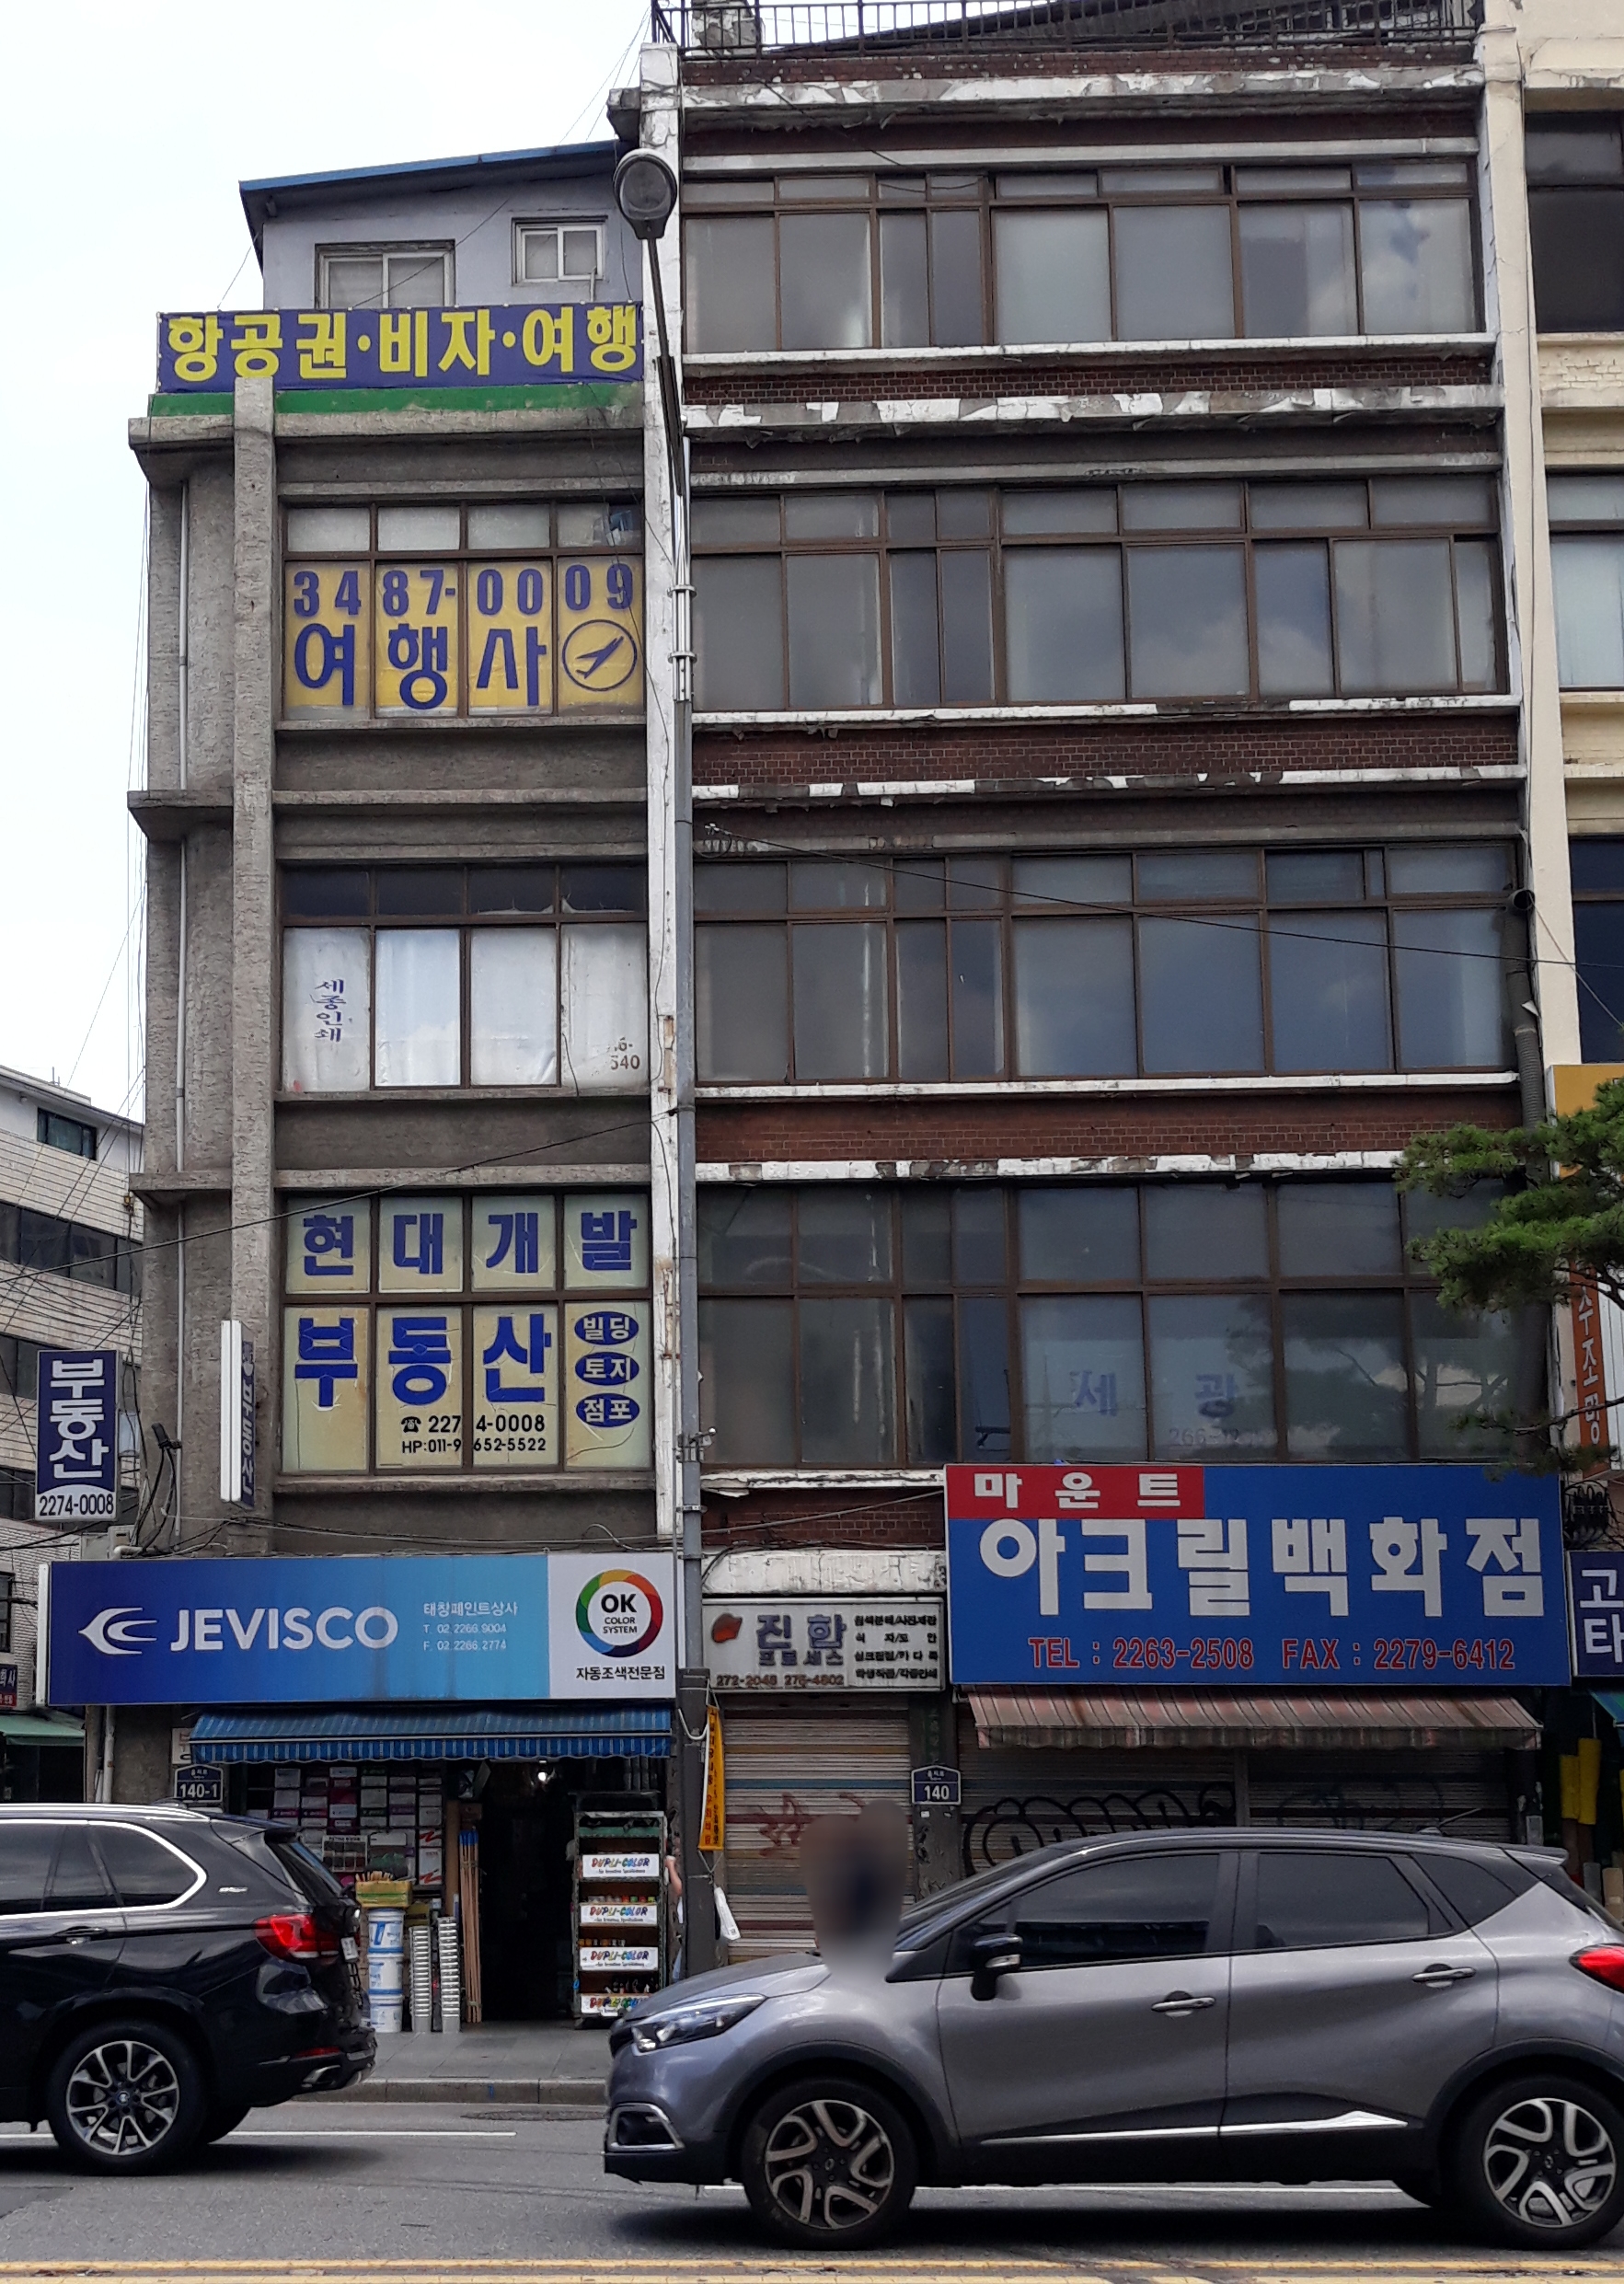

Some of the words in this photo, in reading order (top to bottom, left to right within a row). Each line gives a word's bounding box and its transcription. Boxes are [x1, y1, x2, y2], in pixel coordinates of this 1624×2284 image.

[294, 563, 634, 617] 3487-0009
[294, 623, 547, 709] 여행사
[310, 978, 347, 1043] 세종인쇄
[302, 1210, 638, 1278] 현대개발
[582, 1316, 630, 1341] 빌딩
[294, 1313, 552, 1412] 부동산
[582, 1356, 631, 1381] 토지
[49, 1358, 109, 1479] 부동산
[583, 1398, 633, 1423] 점포
[428, 1413, 546, 1434] 2274-0008
[973, 1471, 1181, 1509] 마운트
[39, 1493, 114, 1517] 2274-0008
[979, 1517, 1546, 1618] 아크릴백화점
[601, 1594, 637, 1613] OK
[170, 1606, 398, 1653] JEVISCO
[603, 1625, 638, 1635] SYSTEM
[604, 1616, 636, 1626] COLOR
[1028, 1637, 1080, 1668] TEL
[1111, 1635, 1255, 1670] 2263-2508
[1282, 1637, 1341, 1670] FAX
[1374, 1636, 1516, 1670] 2279-6412
[576, 1665, 666, 1681] 자동조색전문점
[179, 1782, 218, 1798] 140-1
[924, 1784, 950, 1801] 140
[592, 1857, 651, 1868] DUPLI-COLOR
[590, 1906, 649, 1917] DUPLI-COLOR
[590, 1950, 650, 1961] DUPLI-COLOR
